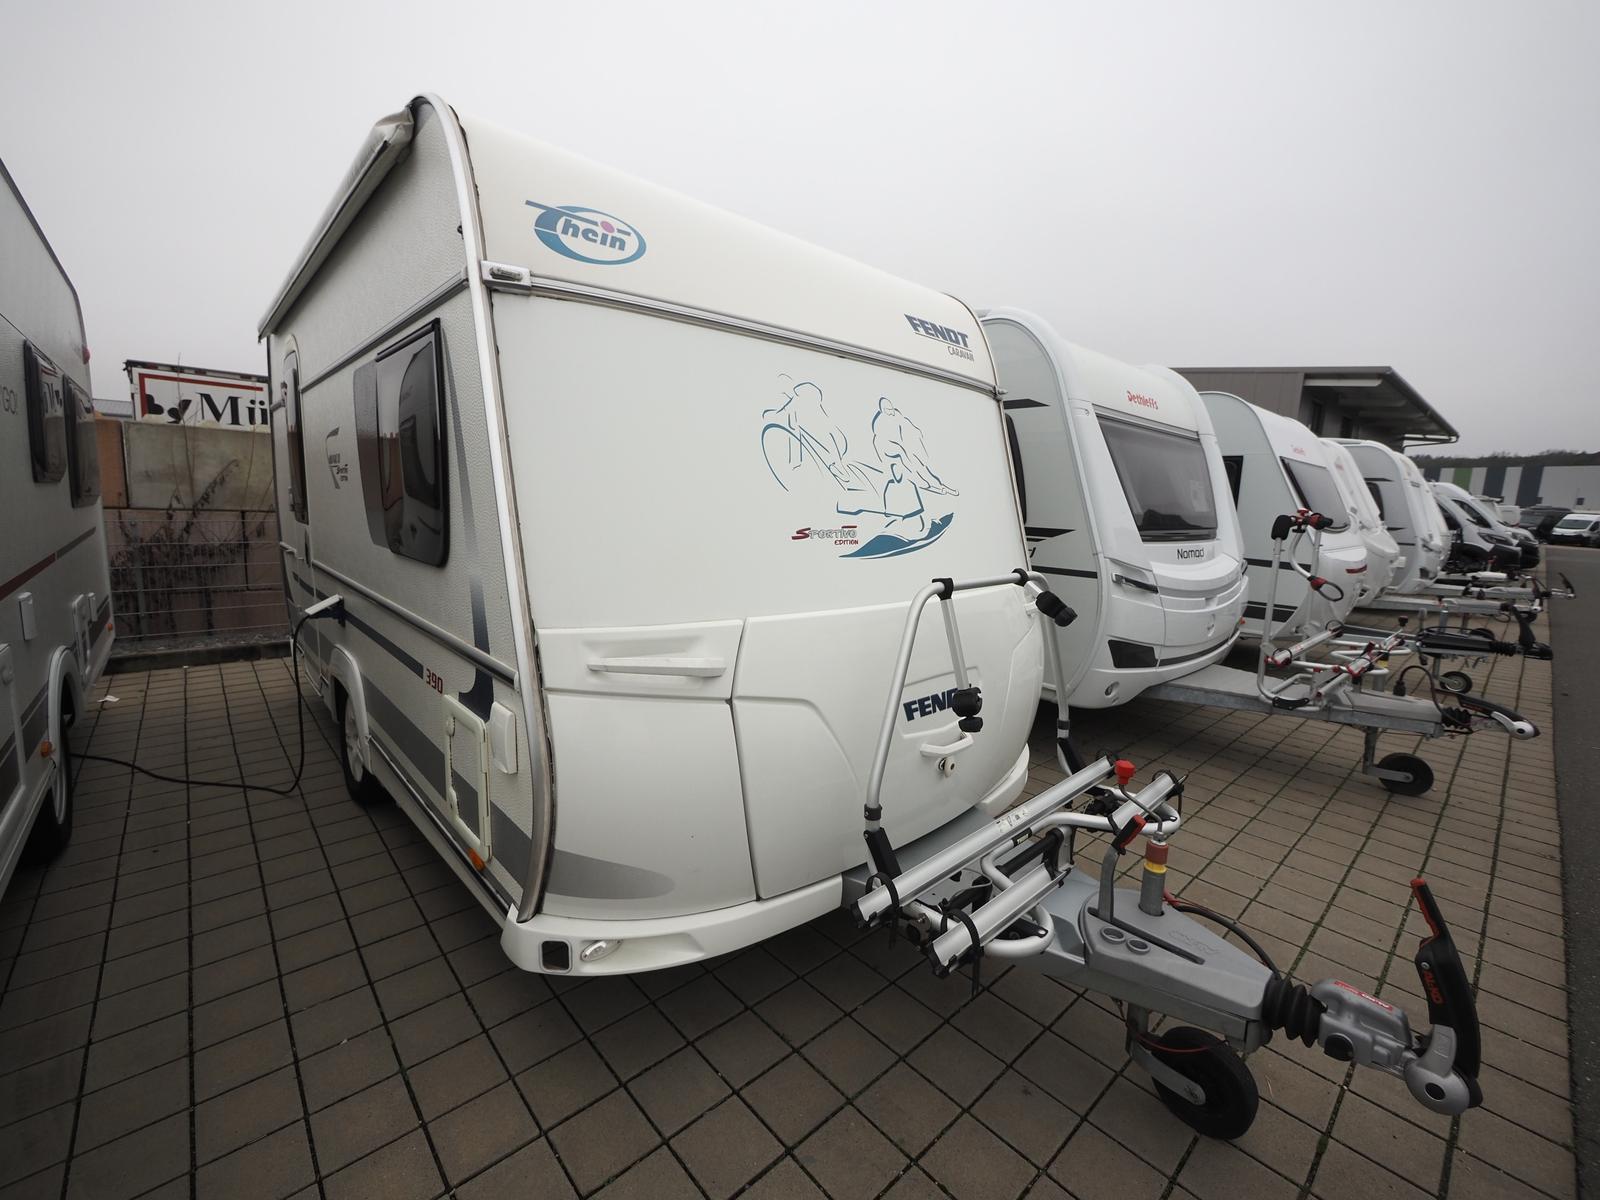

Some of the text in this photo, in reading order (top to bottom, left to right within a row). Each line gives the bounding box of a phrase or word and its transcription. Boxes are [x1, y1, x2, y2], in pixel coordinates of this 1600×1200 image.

[904, 313, 969, 349] FENDT
[947, 345, 975, 361] CARAVAN
[1176, 547, 1205, 560] Nomad
[425, 667, 443, 694] 390
[902, 687, 959, 722] FEND
